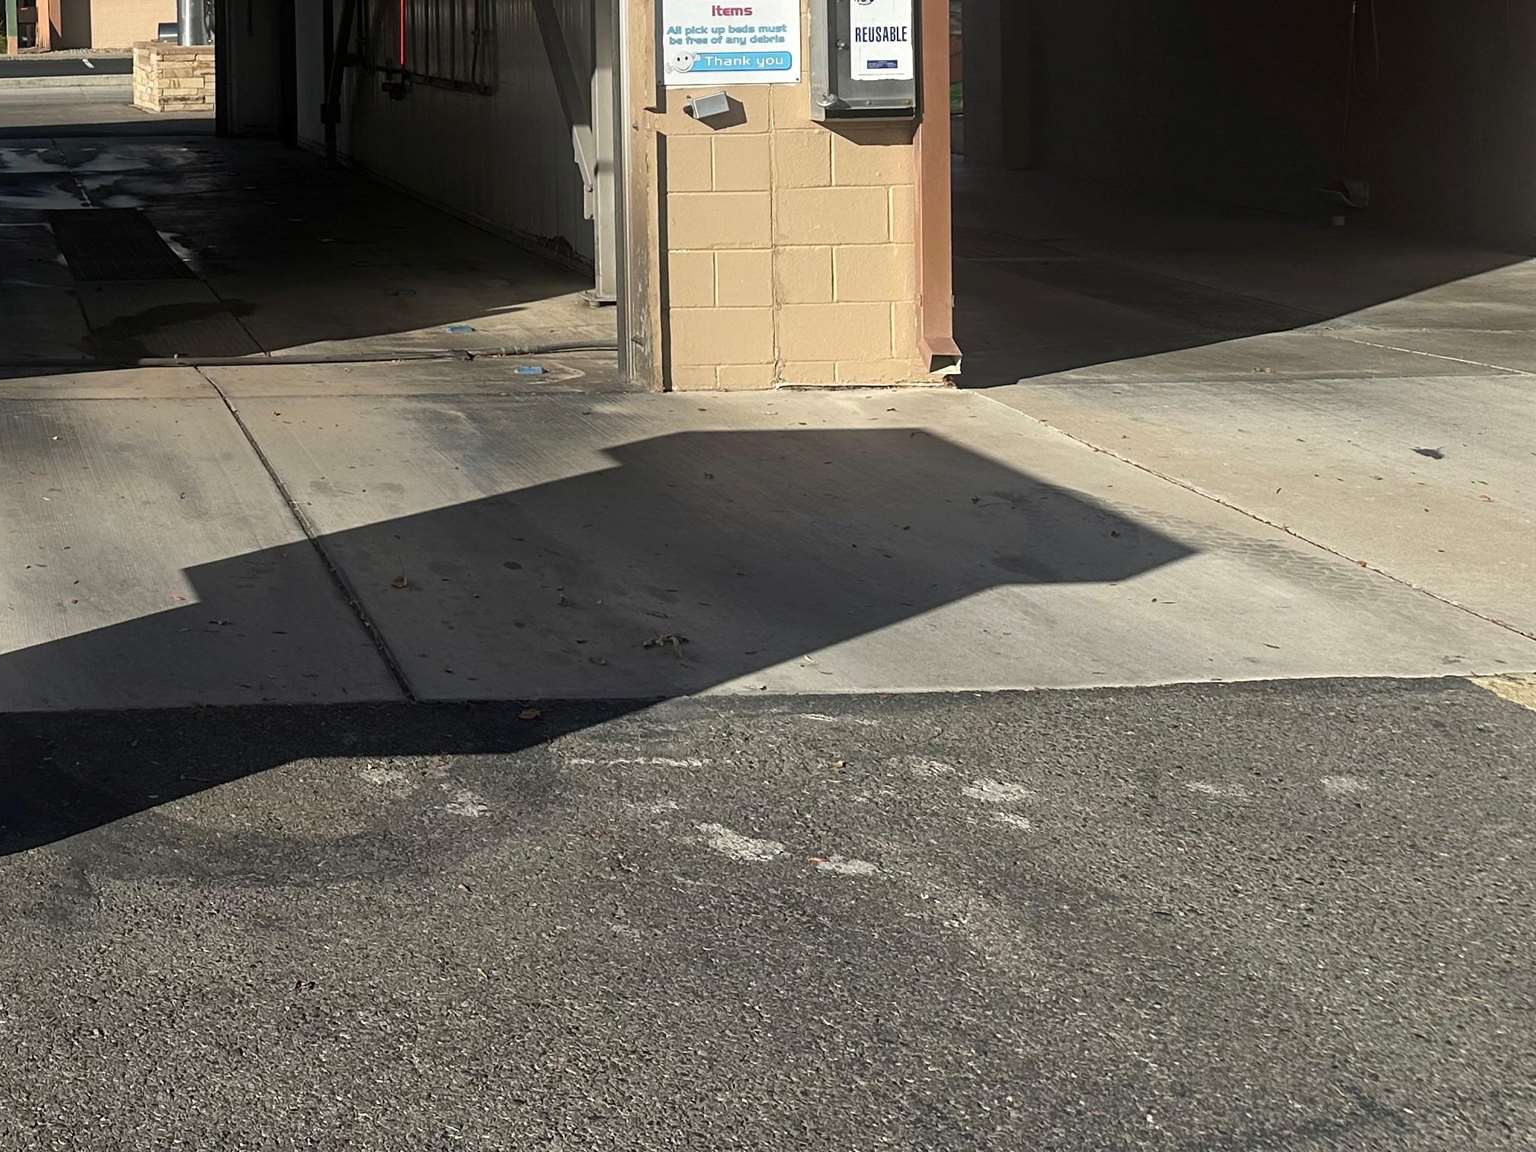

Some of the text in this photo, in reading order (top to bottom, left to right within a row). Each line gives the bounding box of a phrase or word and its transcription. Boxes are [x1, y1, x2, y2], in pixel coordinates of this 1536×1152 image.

[711, 5, 753, 17] Items
[666, 24, 787, 36] All pick up beds must
[855, 26, 908, 42] REUSABLE
[669, 34, 785, 46] be free of any debris
[705, 55, 784, 69] Thank you
